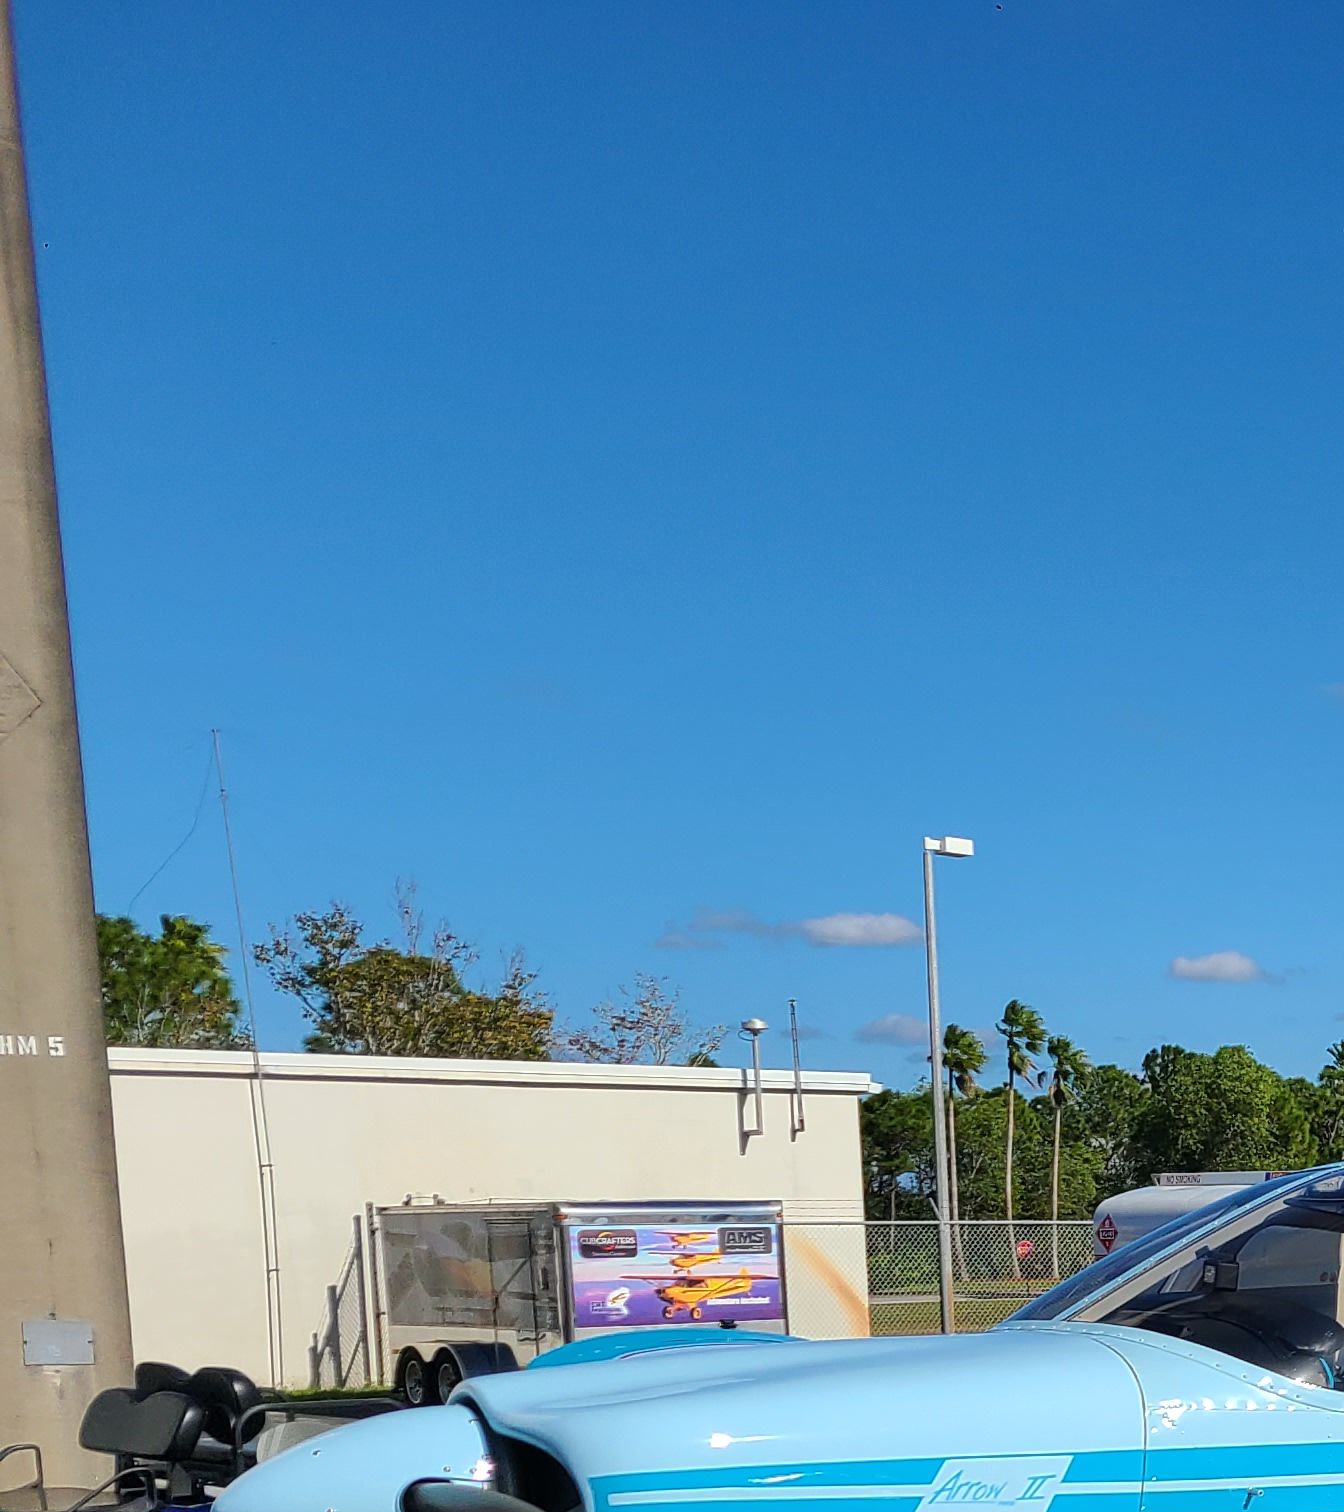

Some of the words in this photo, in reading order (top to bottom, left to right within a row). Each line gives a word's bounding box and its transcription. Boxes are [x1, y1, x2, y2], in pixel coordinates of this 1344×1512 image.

[48, 1036, 64, 1056] 5
[1166, 1175, 1175, 1183] NO
[1176, 1175, 1201, 1184] SMOKING
[928, 1470, 1008, 1504] Arrow
[1016, 1474, 1057, 1501] II
